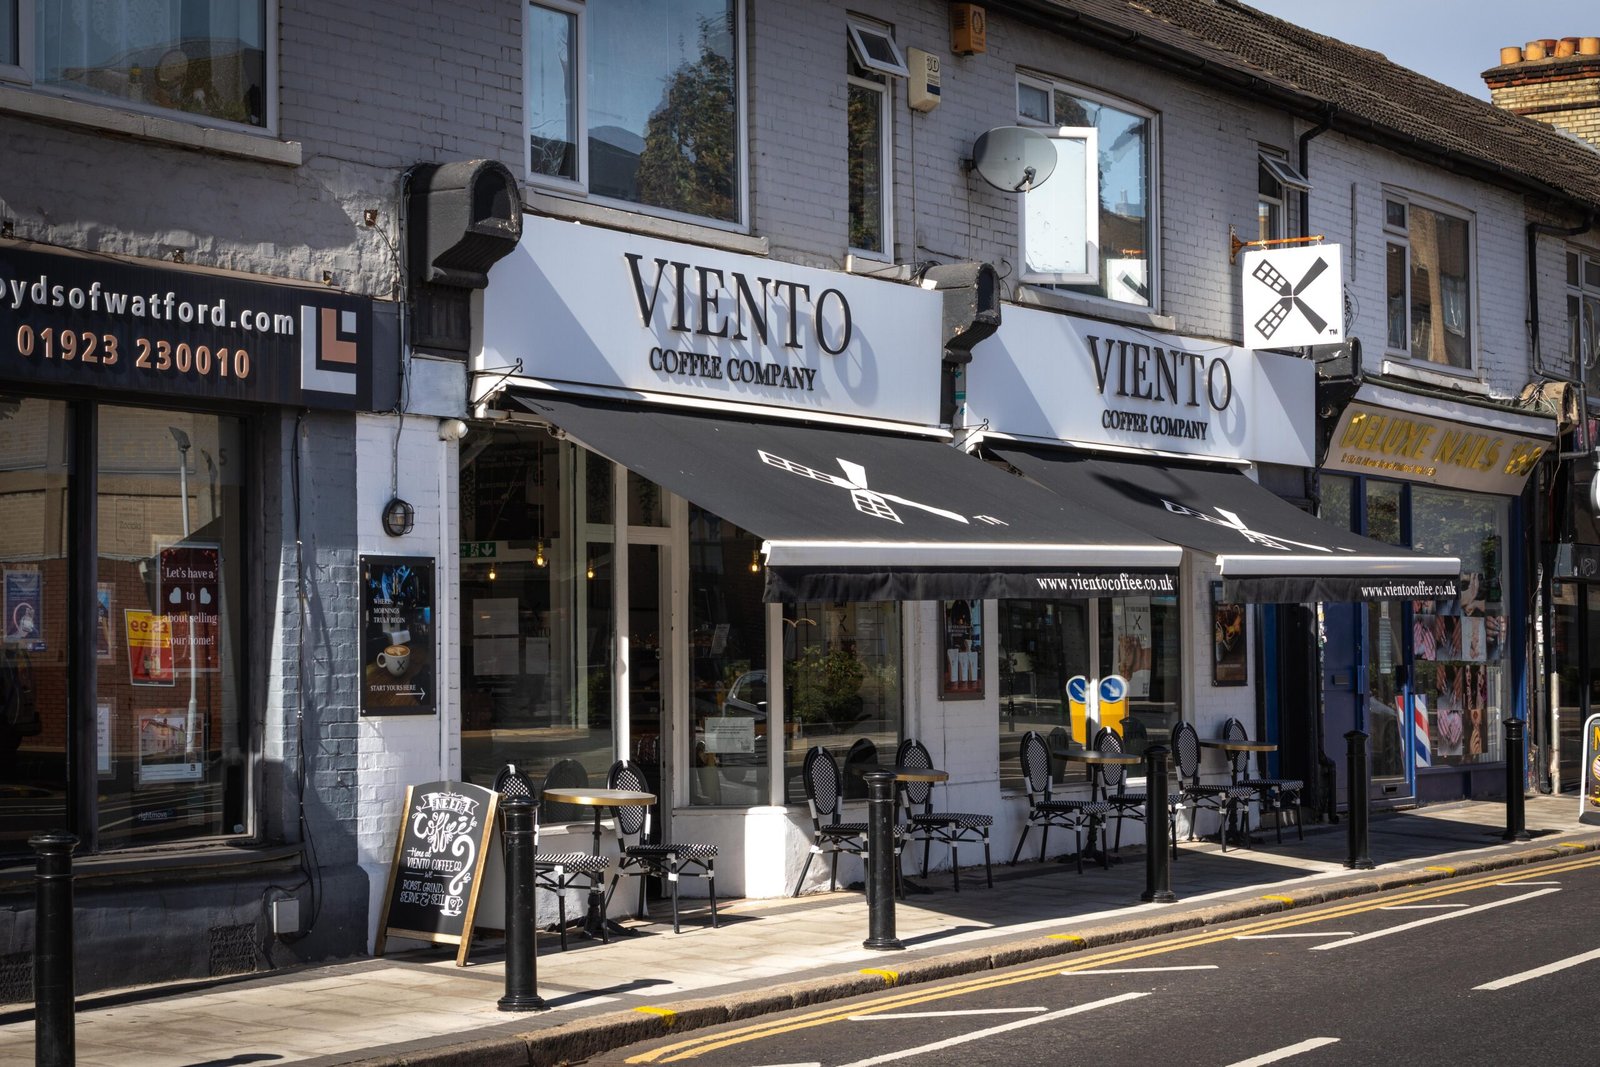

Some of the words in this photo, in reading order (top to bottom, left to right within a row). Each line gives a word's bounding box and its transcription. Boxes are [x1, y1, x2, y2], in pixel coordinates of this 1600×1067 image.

[624, 252, 851, 355] VIENTO
[18, 324, 118, 365] 01923
[136, 338, 250, 379] 230010
[649, 346, 722, 380] COFFEE
[727, 358, 817, 391] COMPANY
[1087, 335, 1232, 411] VIENTO
[1102, 409, 1148, 433] COFFEE
[1150, 416, 1208, 440] COMPANY
[1340, 412, 1437, 460] DELUXE
[1432, 430, 1504, 472] NAILS
[166, 568, 186, 578] Let's
[188, 568, 208, 578] have
[1036, 572, 1174, 590] www.vientocoffee.co.uk
[186, 591, 196, 600] to
[1361, 580, 1456, 597] www.vientocoffee.co.uk
[162, 612, 188, 623] about
[190, 612, 218, 625] selling
[166, 637, 186, 648] your
[188, 635, 214, 646] home!
[370, 684, 385, 692] START
[436, 798, 462, 812] NEED
[407, 857, 431, 869] VIENTO
[432, 859, 454, 872] COFFEE
